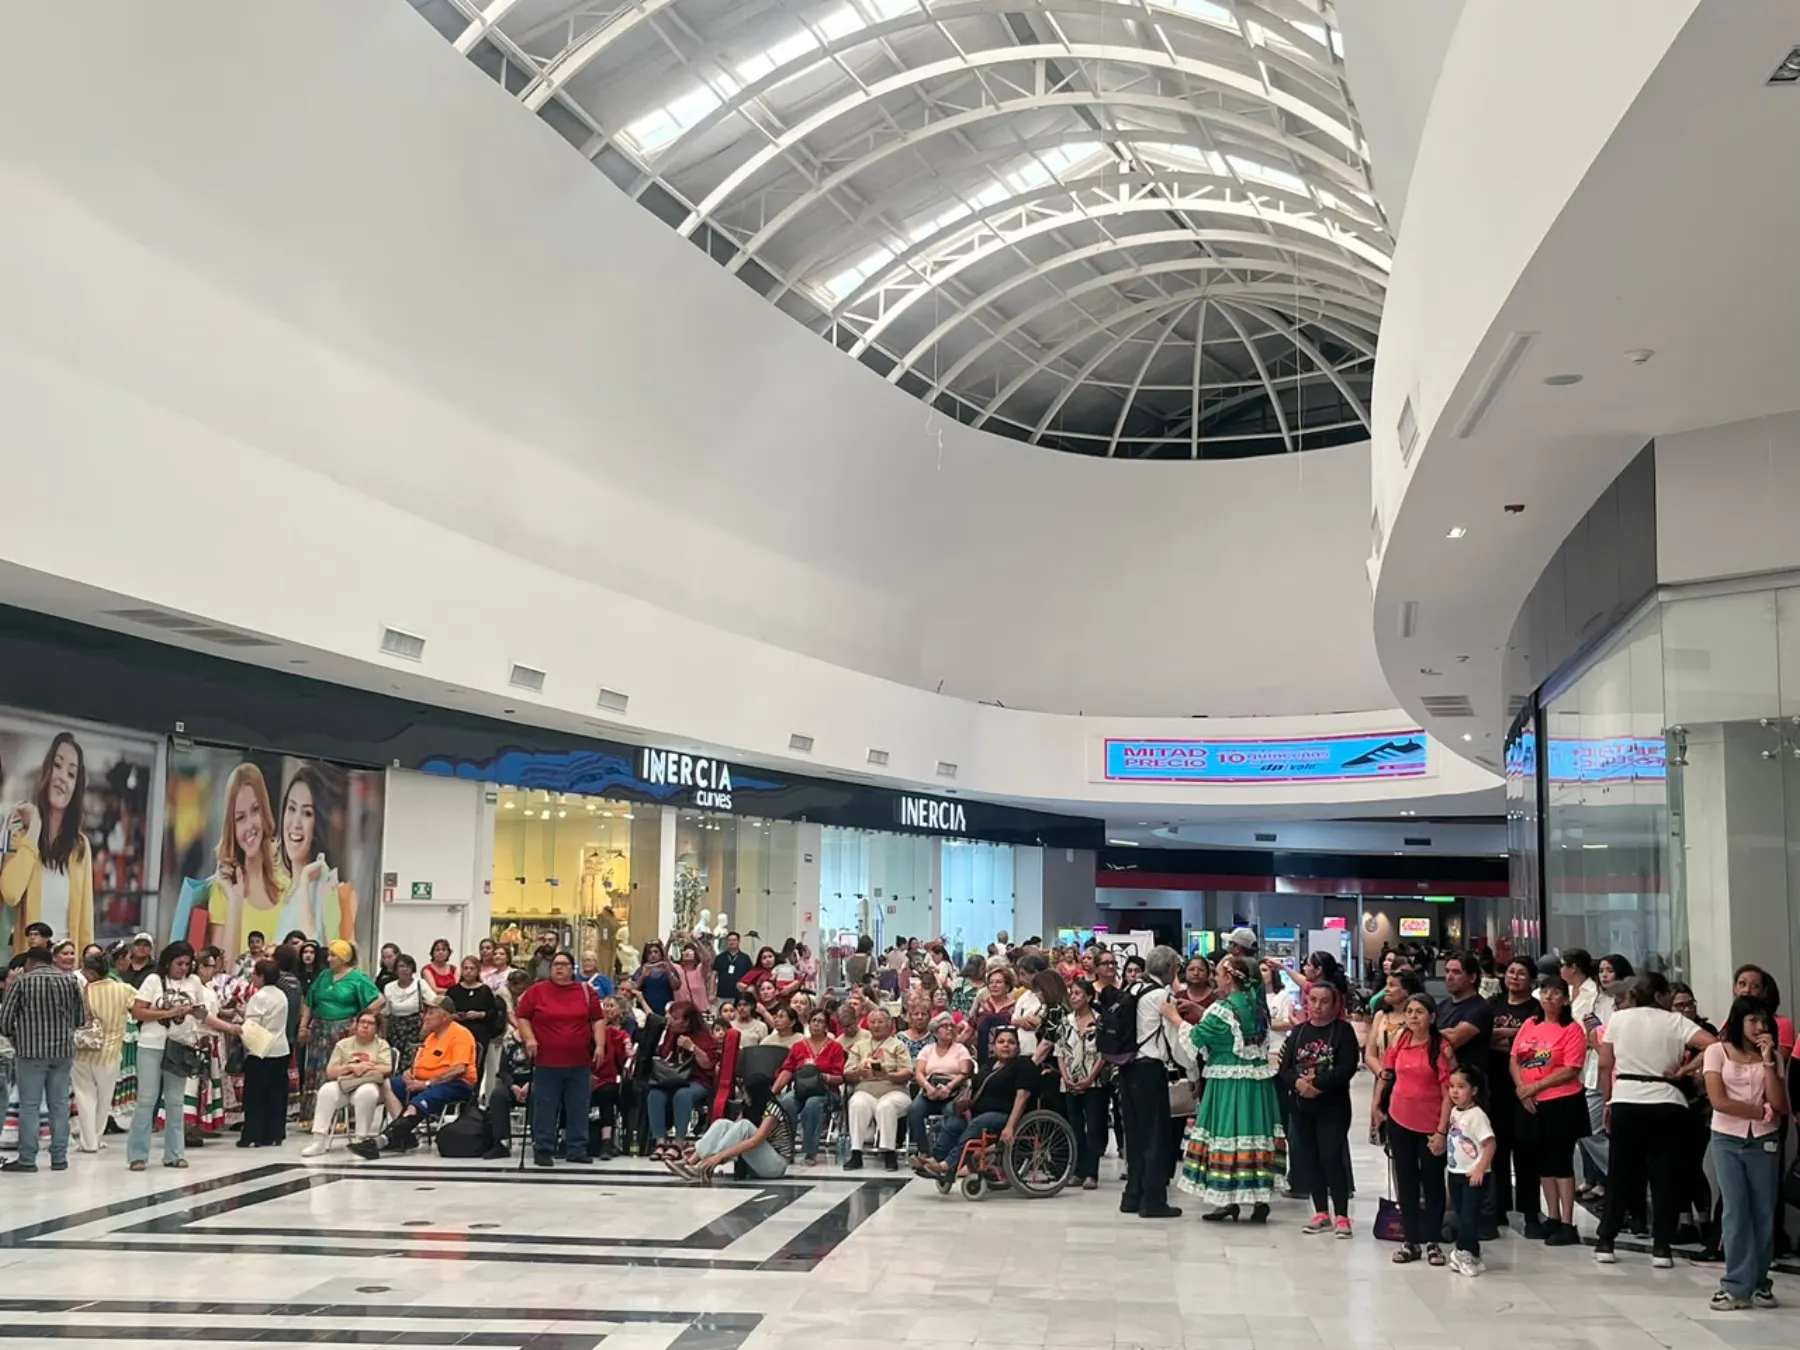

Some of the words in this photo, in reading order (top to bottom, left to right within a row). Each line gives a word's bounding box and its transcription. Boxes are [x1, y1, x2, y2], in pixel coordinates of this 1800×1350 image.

[1124, 747, 1208, 757] MITAD
[1219, 753, 1246, 763] 10
[643, 748, 732, 791] INERCIA
[1125, 758, 1208, 768] PRECIO
[696, 790, 732, 810] curves
[901, 796, 967, 832] INERCIA
